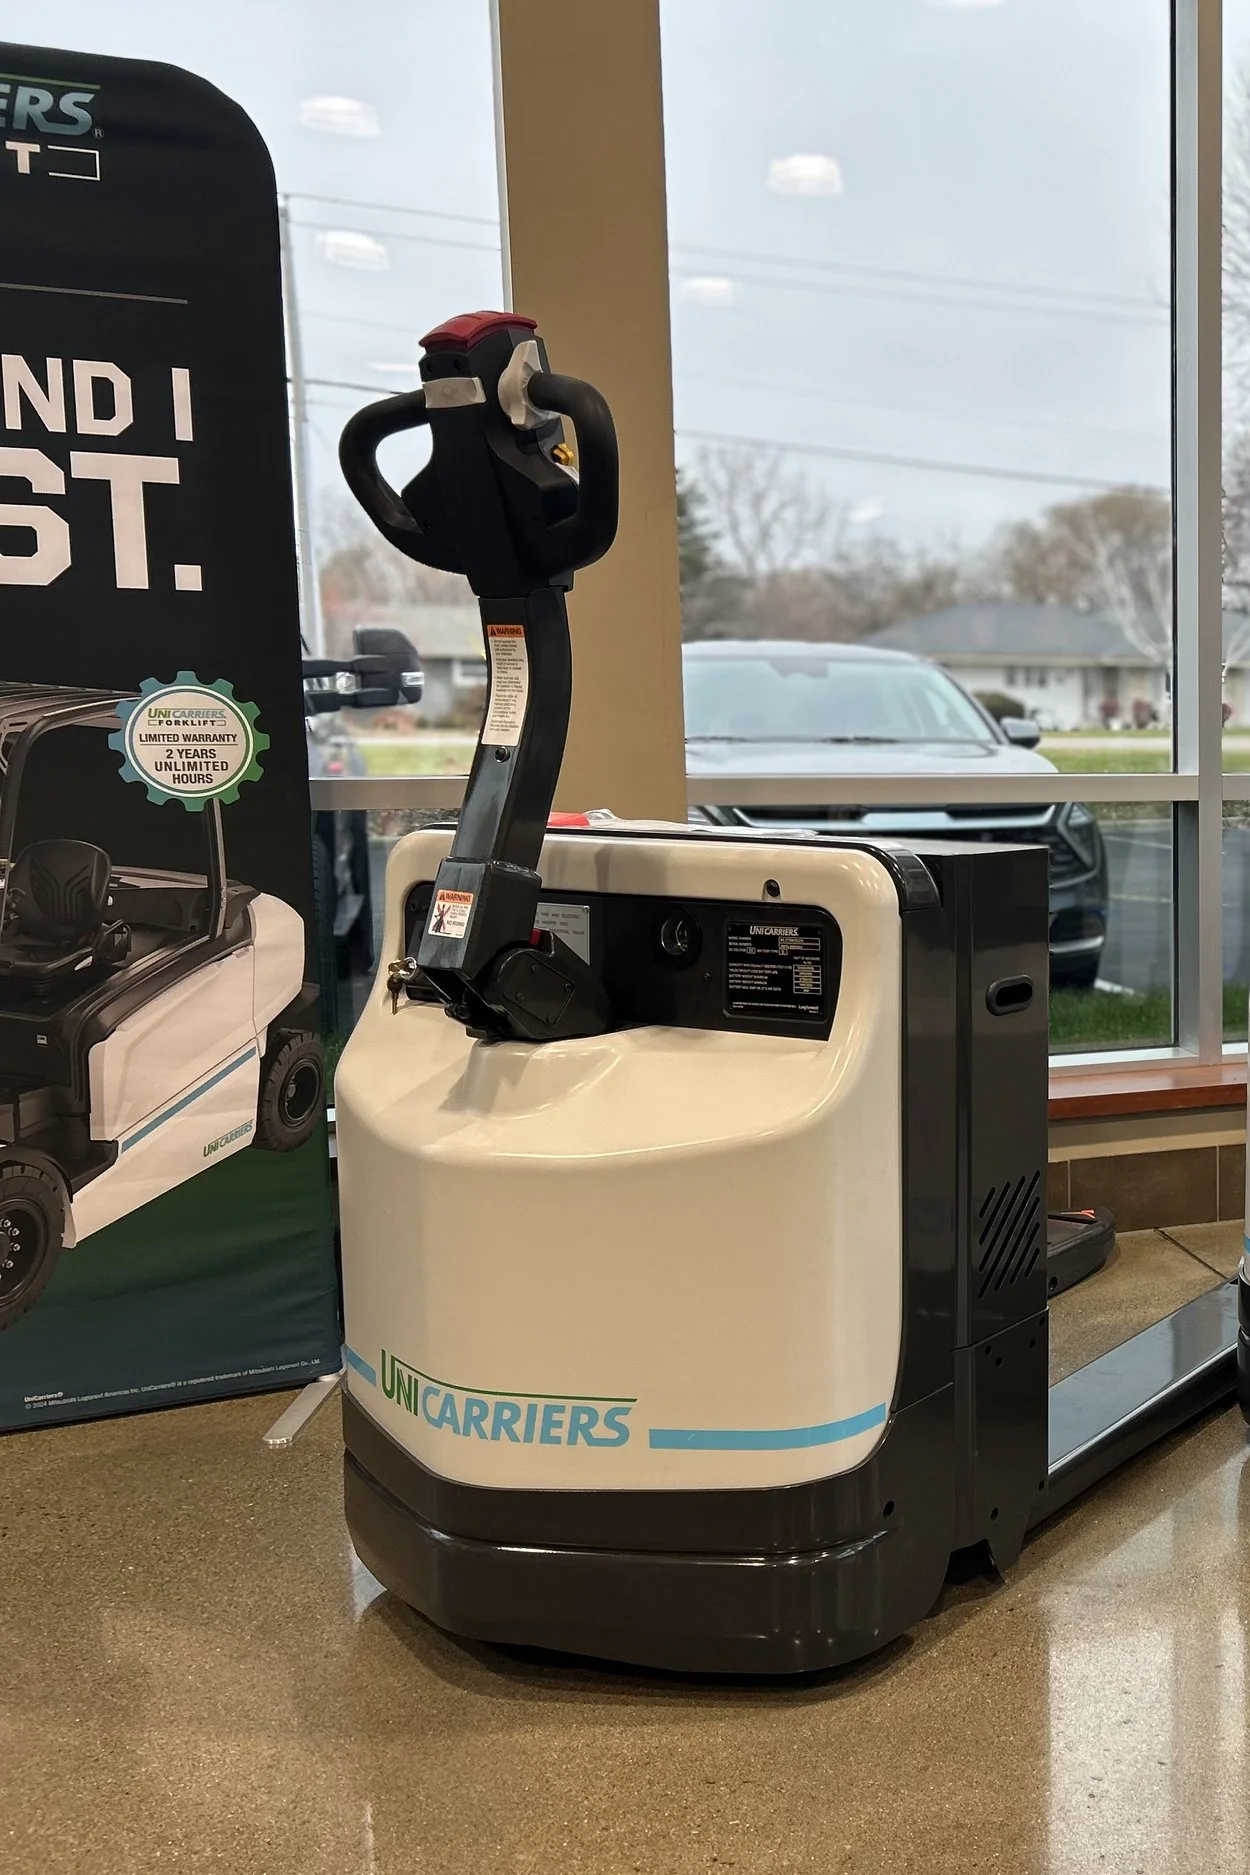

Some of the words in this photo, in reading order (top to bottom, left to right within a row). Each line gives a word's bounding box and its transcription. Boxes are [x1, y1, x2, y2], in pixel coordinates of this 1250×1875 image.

[171, 367, 194, 442] I
[496, 627, 522, 636] WARNING
[158, 719, 216, 727] FORKLIFT
[139, 733, 179, 743] LIMITED
[182, 733, 238, 743] WARRANTY
[165, 749, 174, 759] 2
[177, 749, 216, 759] YEARS
[154, 761, 229, 772] UNLIMITED
[172, 773, 214, 784] HOURS
[445, 892, 471, 903] WARNING
[381, 1348, 634, 1448] UNICARRIERS
